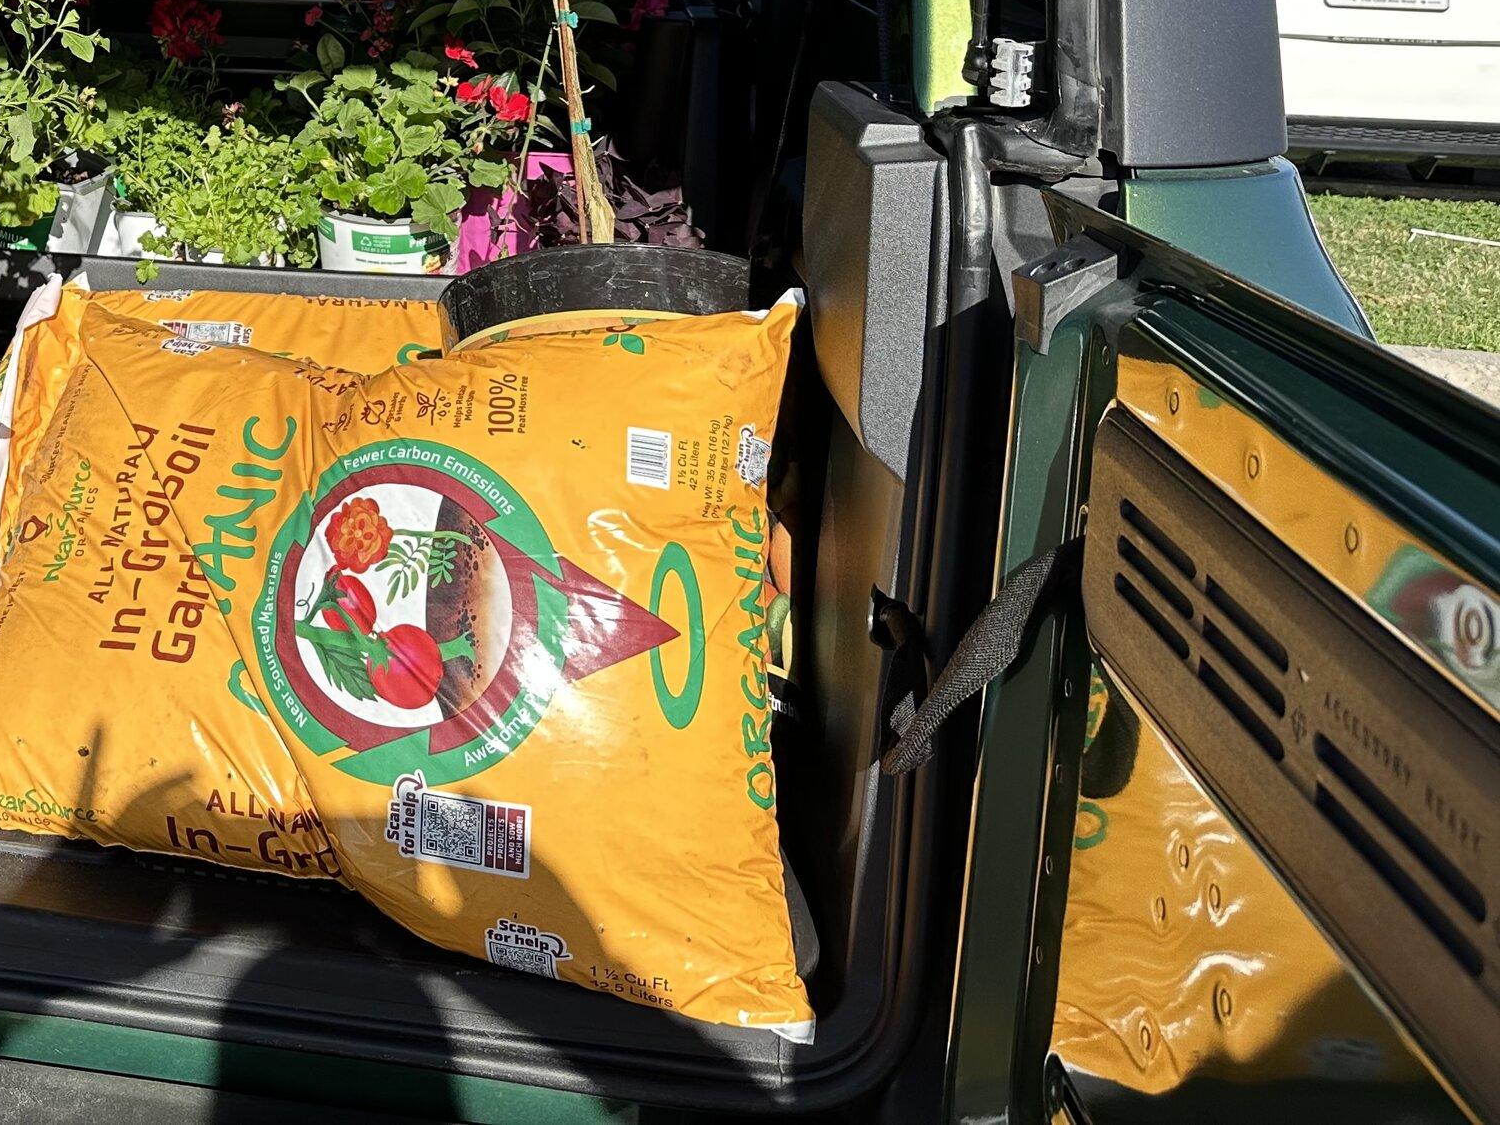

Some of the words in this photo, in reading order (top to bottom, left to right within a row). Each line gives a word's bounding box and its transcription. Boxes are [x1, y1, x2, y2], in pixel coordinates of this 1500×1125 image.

[519, 375, 529, 395] Free
[452, 406, 463, 428] Helps
[488, 373, 518, 437] 100%
[518, 396, 528, 416] Moss
[517, 417, 527, 435] Peat
[343, 447, 386, 472] Fewer
[388, 444, 441, 467] Carbon
[442, 455, 517, 516] Emissions
[88, 558, 114, 605] ALL
[264, 550, 283, 624] Materials
[152, 553, 211, 664] Gard
[256, 625, 285, 692] Sourced
[280, 687, 308, 728] Near
[463, 706, 532, 768] Aweome
[1323, 691, 1412, 787] ACCESSORY
[1424, 785, 1482, 854] READY
[206, 788, 264, 820] ALL
[386, 801, 401, 842] Scan
[401, 791, 419, 829] help
[400, 830, 415, 856] for
[485, 817, 496, 858] PROJECTS
[497, 817, 506, 860] PRODUCTS
[507, 838, 516, 859] AND
[508, 821, 517, 838] SOW
[514, 840, 523, 866] MUCH
[486, 928, 512, 944] for
[514, 933, 550, 953] help
[498, 919, 538, 936] Scan
[628, 985, 674, 1009] Liters
